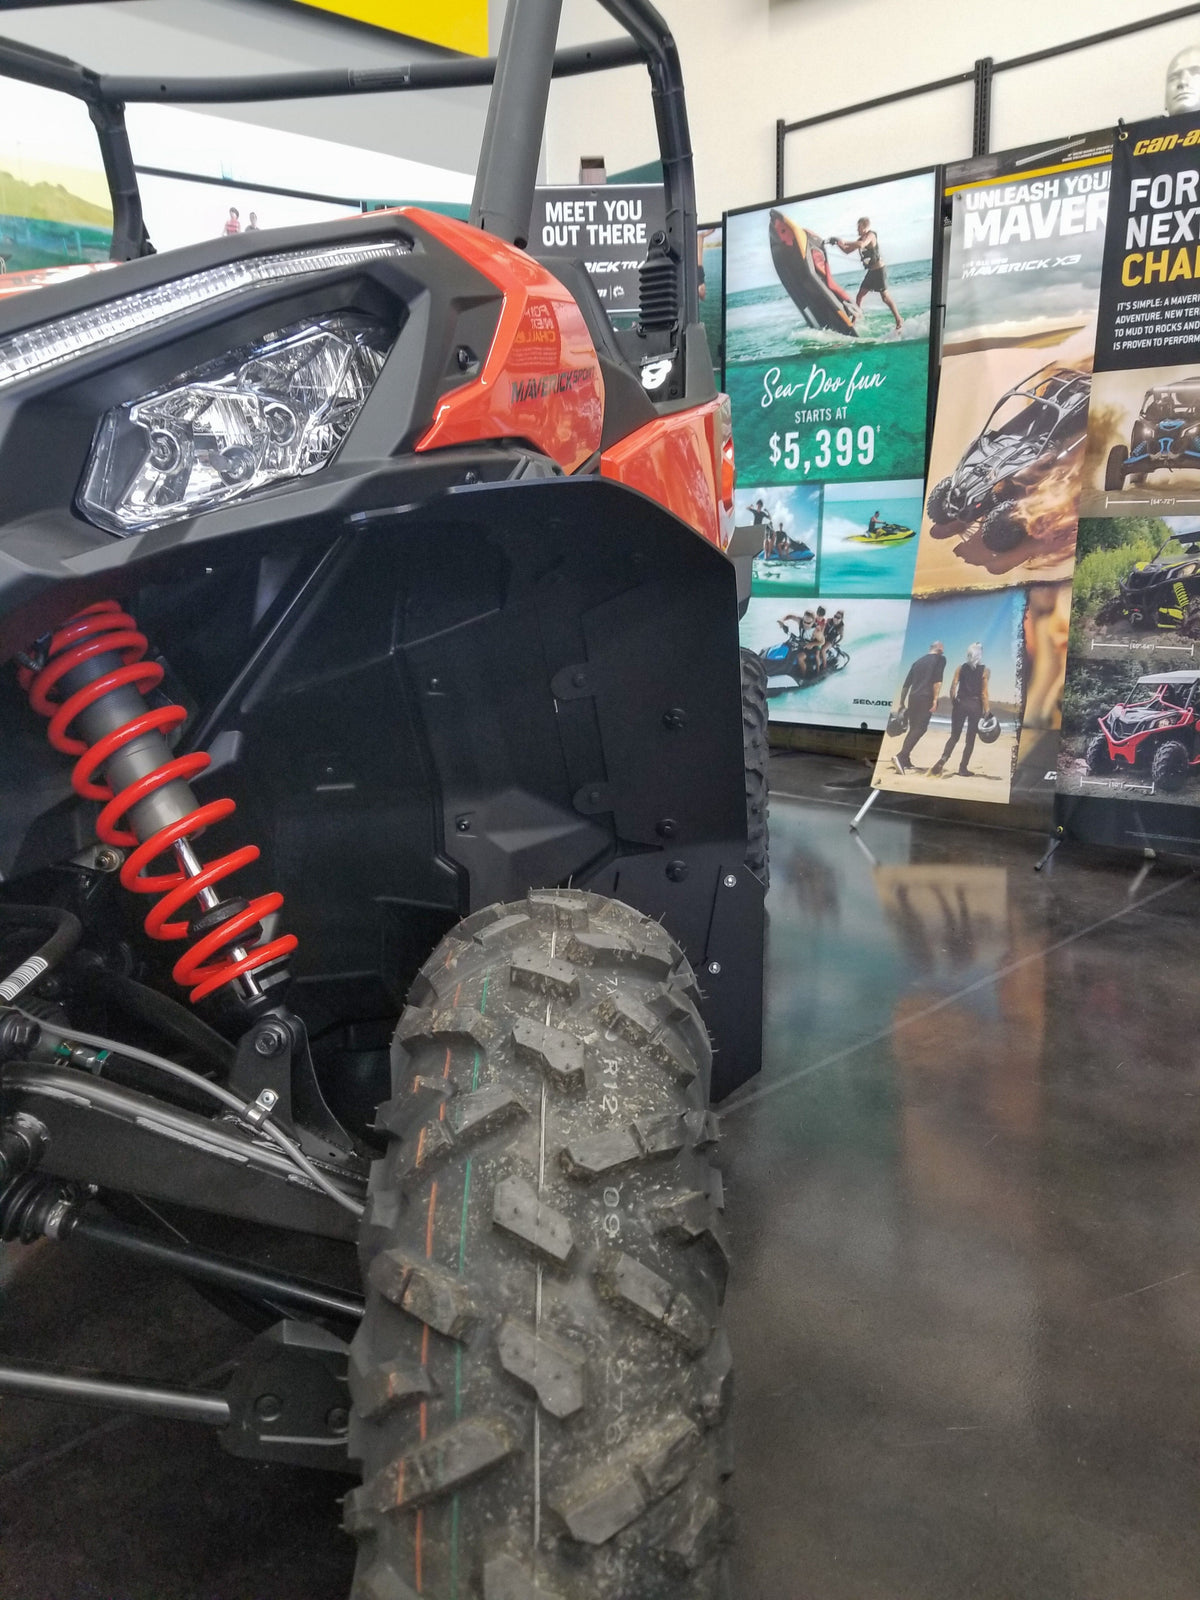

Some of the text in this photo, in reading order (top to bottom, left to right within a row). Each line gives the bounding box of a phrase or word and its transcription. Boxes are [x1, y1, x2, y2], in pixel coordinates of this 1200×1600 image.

[965, 178, 1060, 211] UNLEASH
[1128, 169, 1200, 213] FOR
[545, 199, 642, 223] MEET YOU
[542, 223, 647, 247] OUT THERE
[961, 253, 1083, 280] MAVERICK X3
[1115, 307, 1200, 325] ADVENTURE. NEW TER
[1116, 301, 1131, 312] IT'S
[1132, 297, 1163, 310] SIMPLE:
[1164, 297, 1169, 306] A
[1114, 328, 1124, 338] TO
[1125, 326, 1143, 337] MUD
[1144, 325, 1154, 334] TO
[1155, 322, 1182, 333] ROCKS
[1113, 341, 1121, 351] IS
[1122, 338, 1152, 350] PROVEN
[1153, 337, 1162, 347] TO
[511, 371, 573, 404] MAVERICK
[761, 361, 887, 408] Sea-Doo fun
[794, 406, 848, 424] STARTS AT
